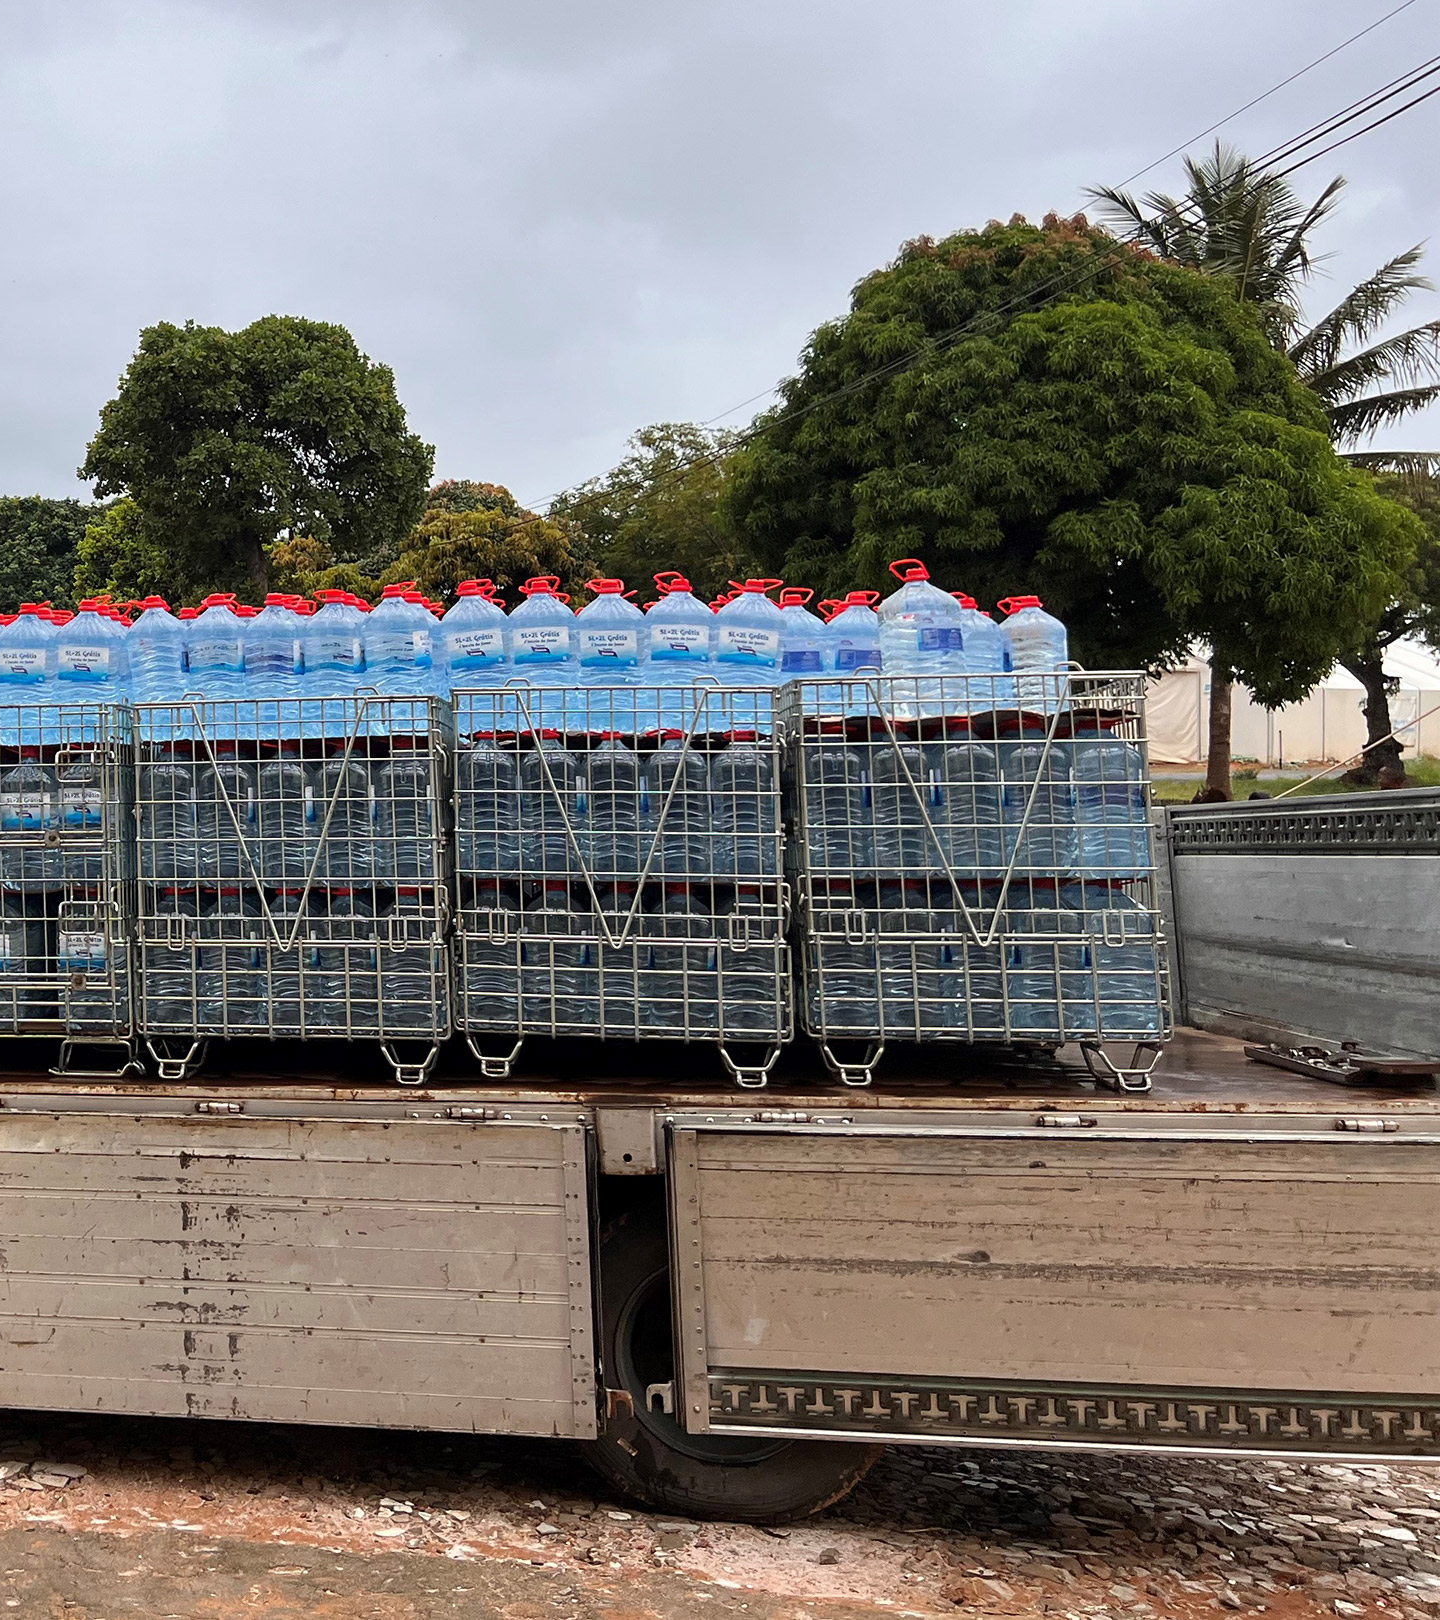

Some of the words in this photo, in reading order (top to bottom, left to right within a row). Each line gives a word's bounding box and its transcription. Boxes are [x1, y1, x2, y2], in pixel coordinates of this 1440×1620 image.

[473, 634, 494, 642] Grátis
[748, 633, 769, 641] Grátis
[82, 650, 101, 658] Grátis
